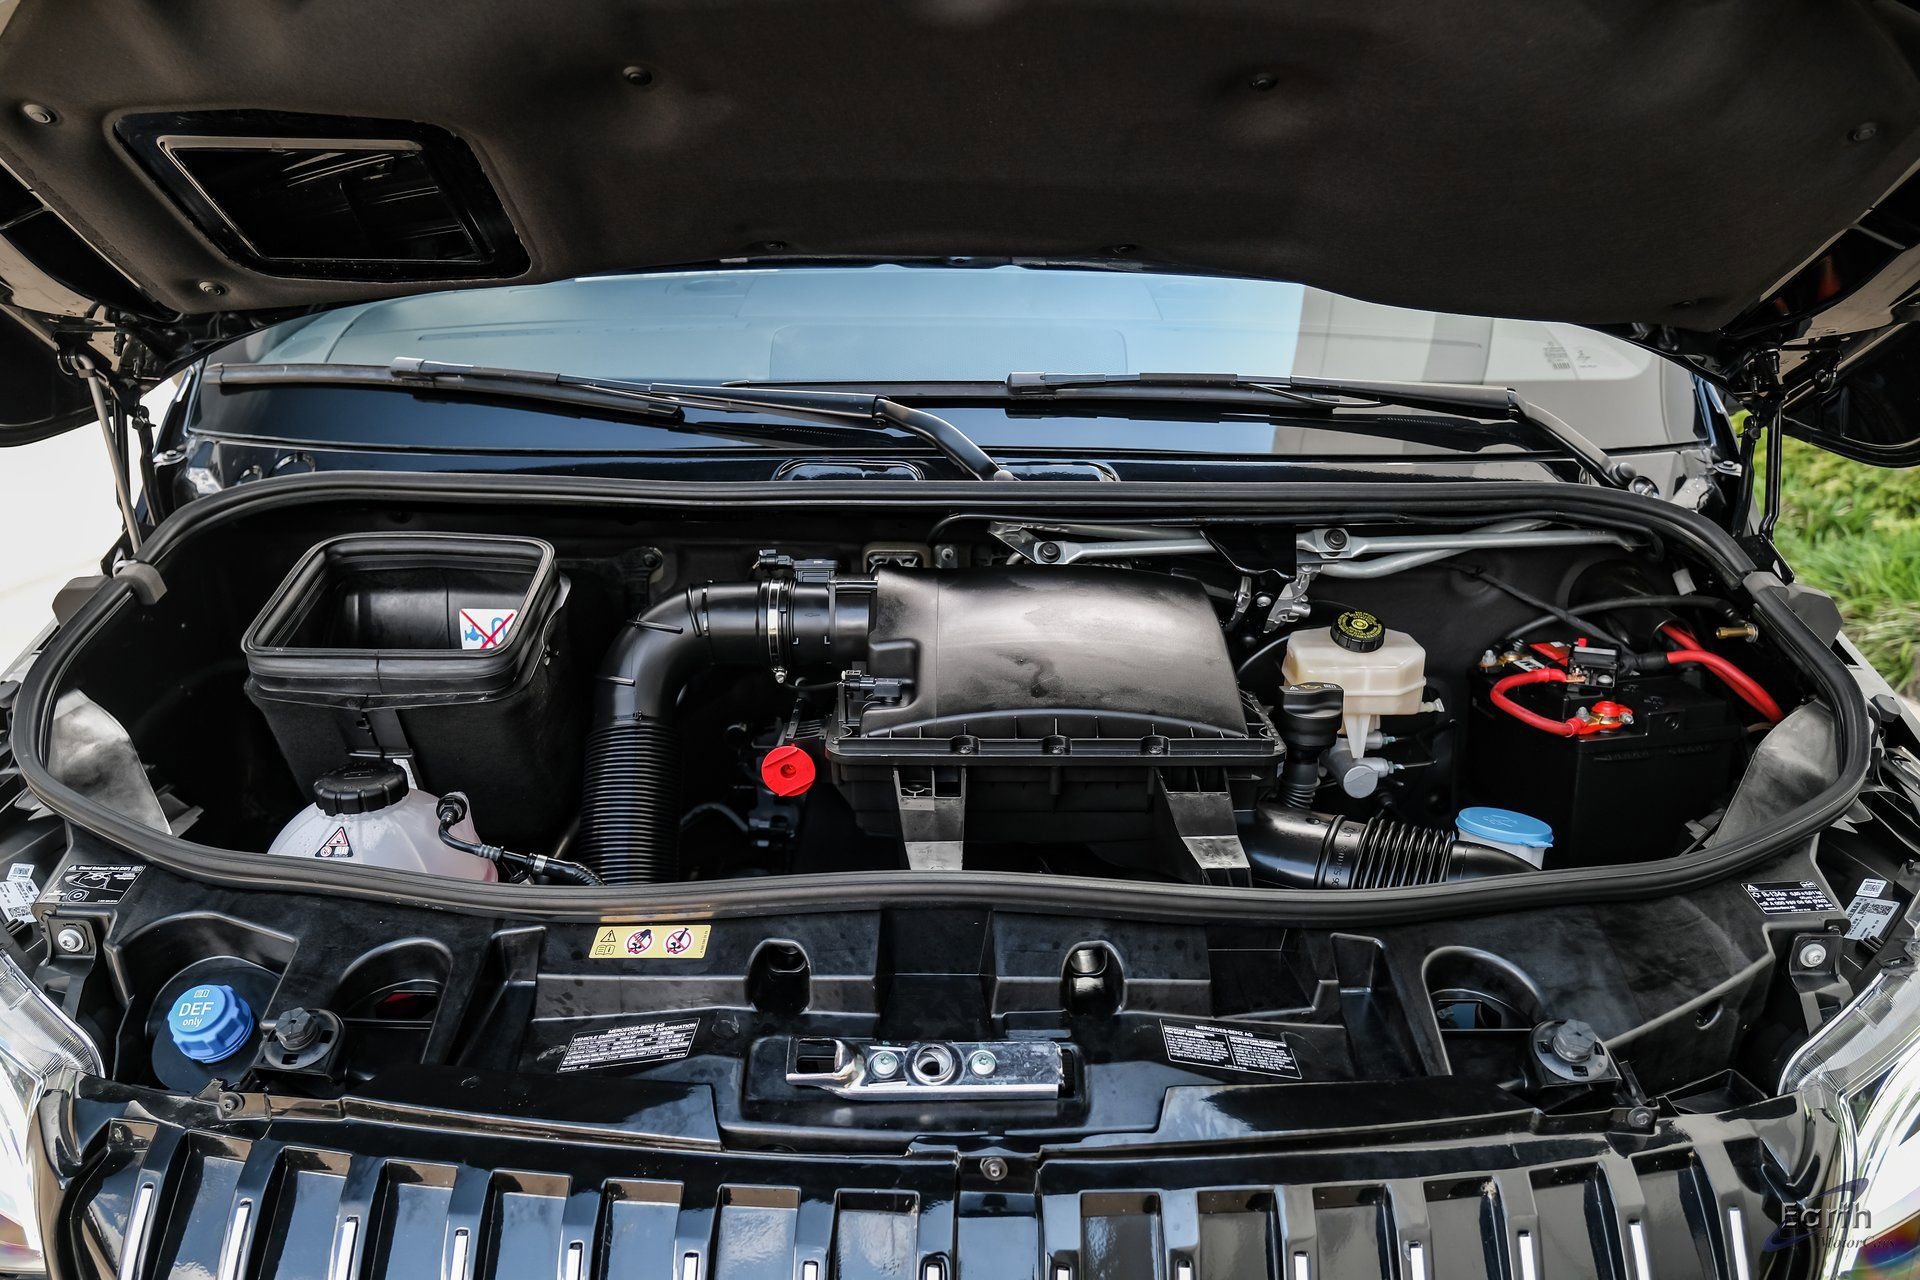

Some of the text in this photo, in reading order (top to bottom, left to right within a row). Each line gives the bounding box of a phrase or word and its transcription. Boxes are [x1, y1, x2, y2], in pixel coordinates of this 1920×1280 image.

[178, 1002, 214, 1016] DEF
[182, 1017, 202, 1027] only
[627, 1028, 654, 1036] CONTROL
[655, 1023, 697, 1032] INFORMATION
[1195, 1025, 1243, 1036] MERCEDES-BENZ
